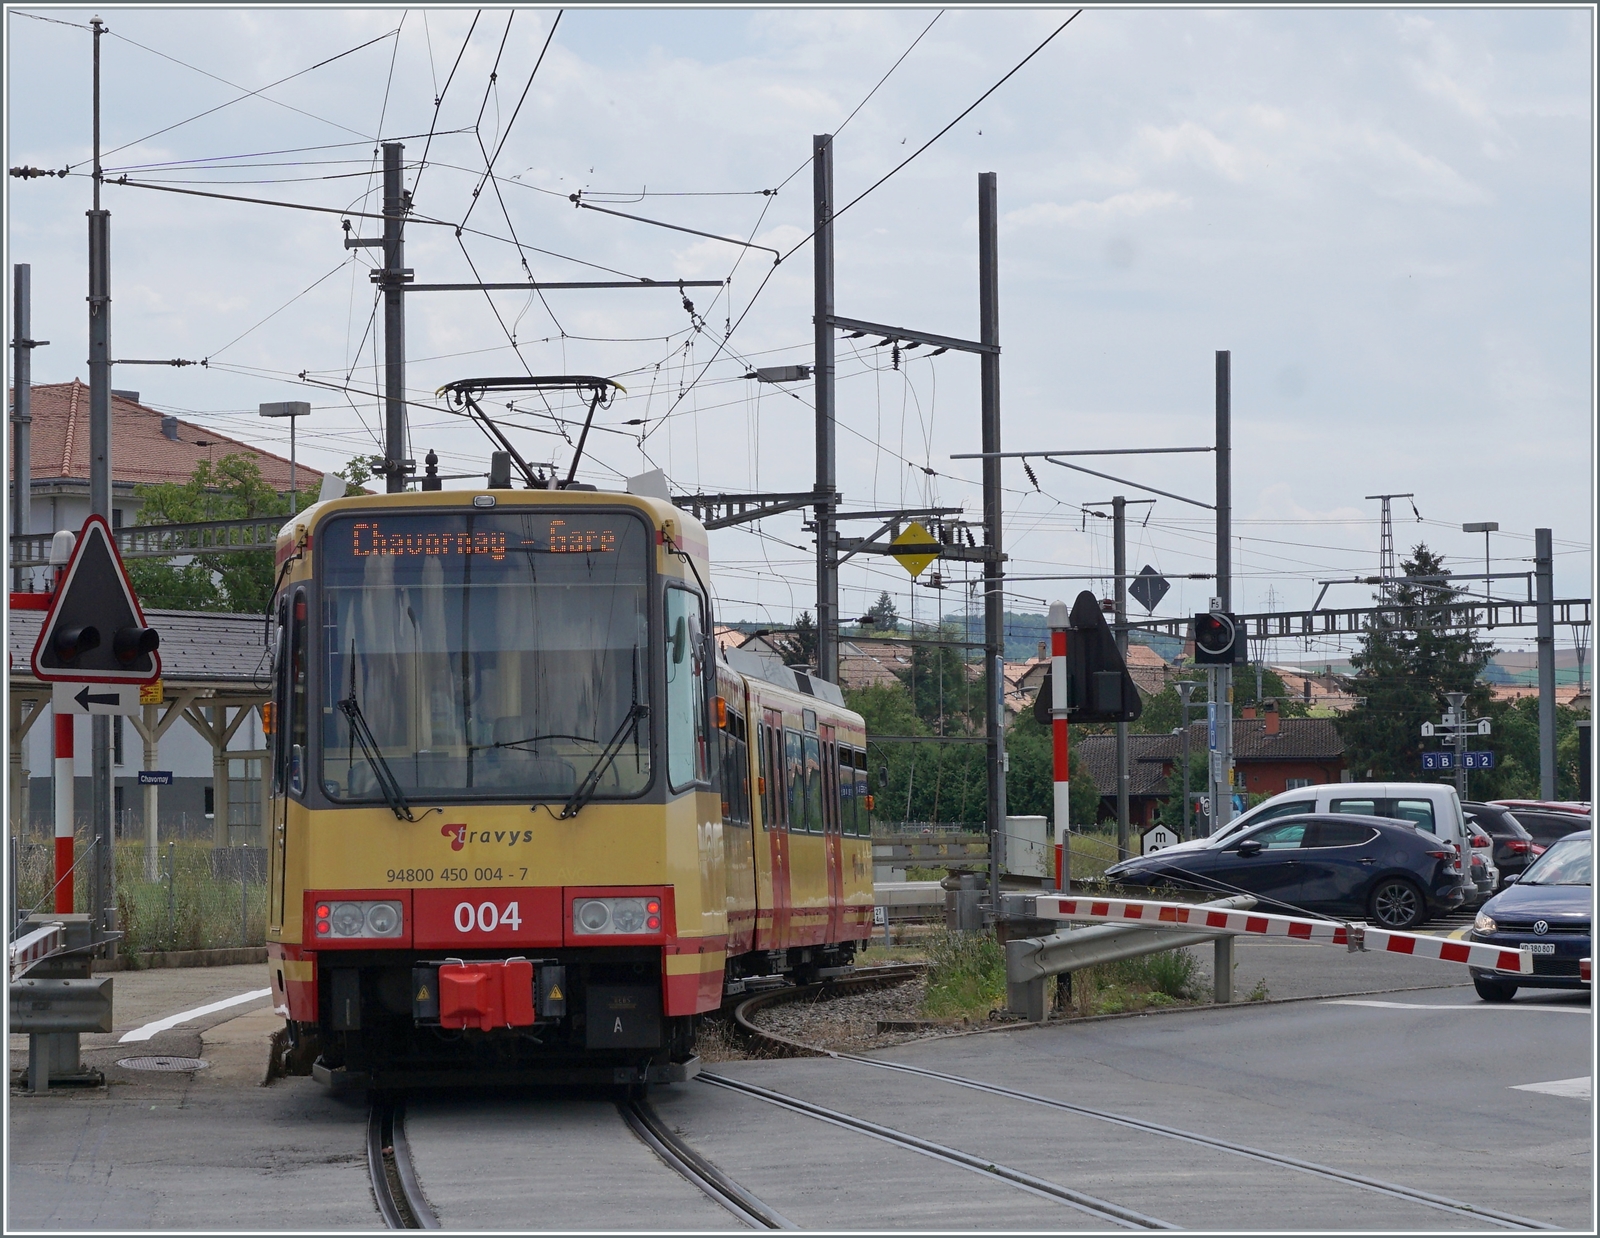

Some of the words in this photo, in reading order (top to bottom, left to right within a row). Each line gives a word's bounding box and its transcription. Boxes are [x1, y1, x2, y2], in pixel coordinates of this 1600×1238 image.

[353, 523, 506, 560] Chavornay
[551, 520, 615, 553] Gare
[1427, 758, 1434, 767] 3
[1442, 758, 1449, 767] B
[1467, 757, 1474, 766] B
[1482, 756, 1489, 766] 2
[140, 775, 169, 785] Chavornay
[456, 826, 533, 847] travys
[1155, 831, 1166, 843] m
[386, 867, 434, 883] 94800
[440, 867, 468, 882] 450
[474, 867, 503, 881] 004
[519, 867, 528, 881] 7
[453, 901, 522, 933] 004
[613, 1016, 624, 1033] A
